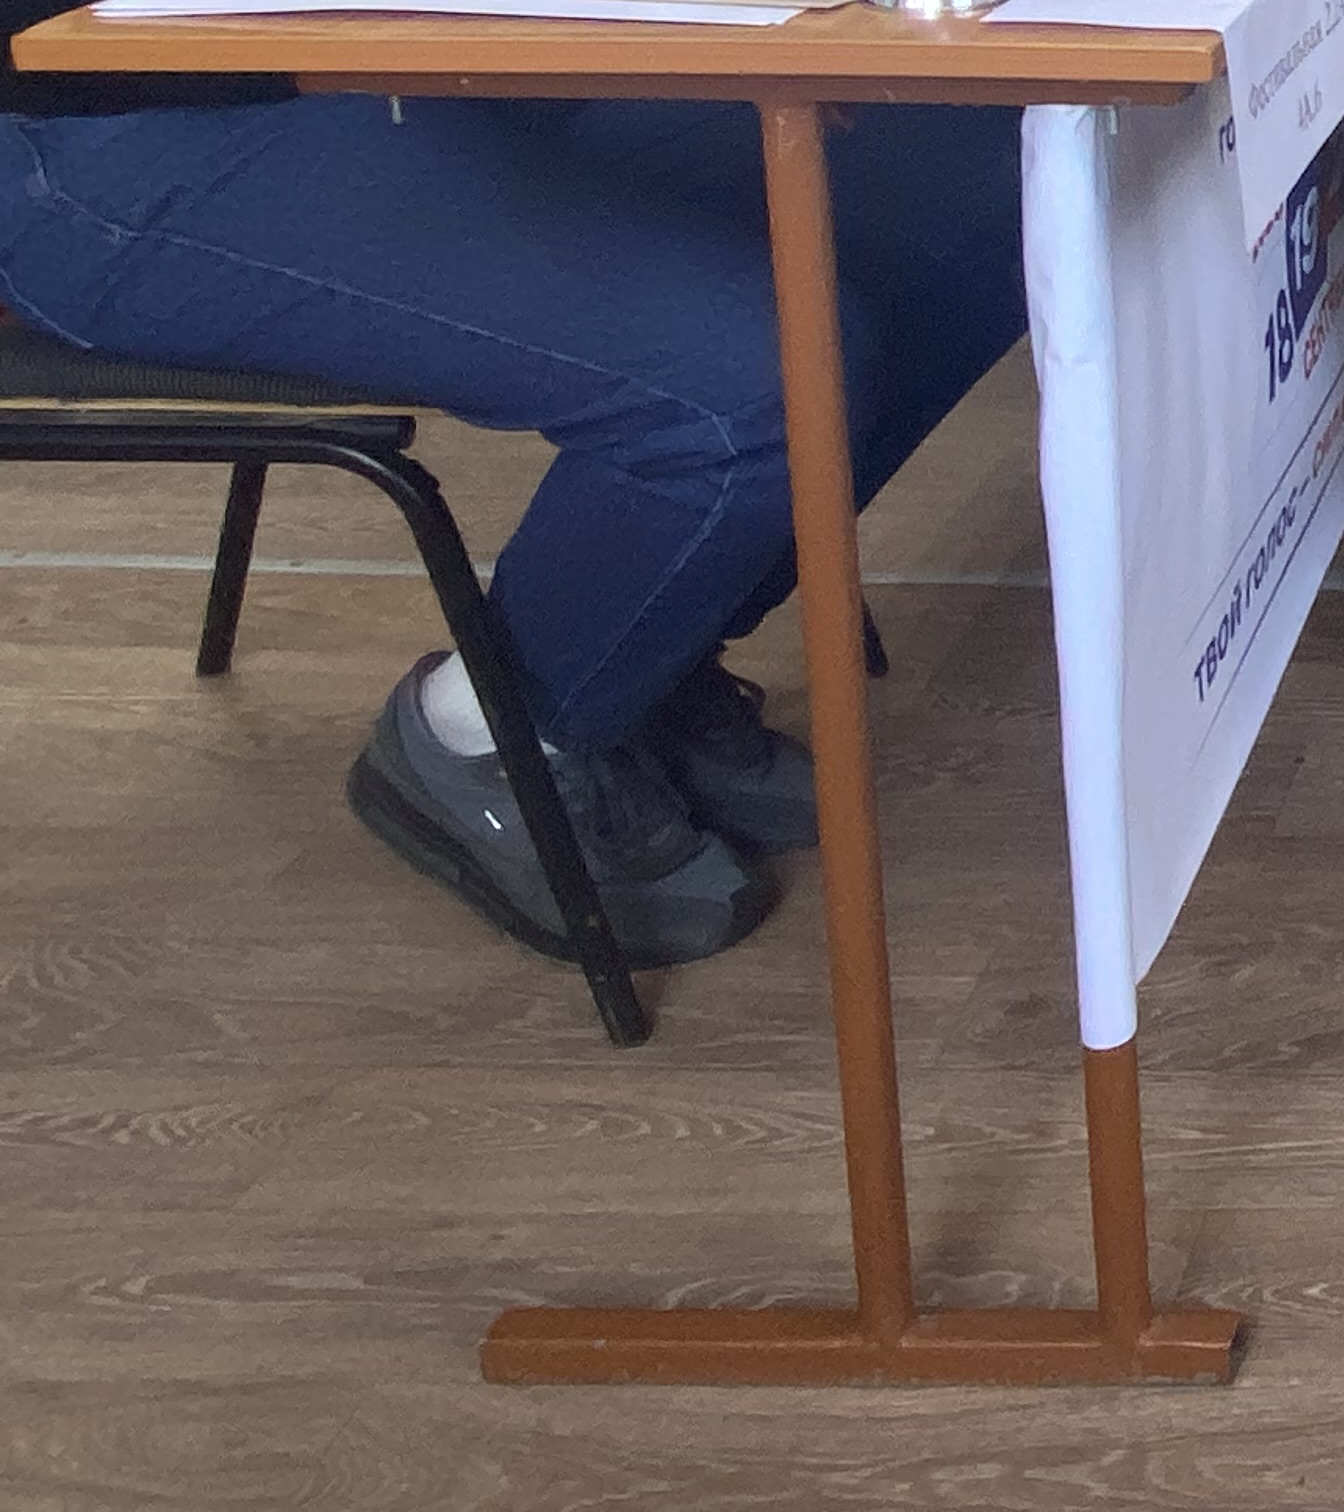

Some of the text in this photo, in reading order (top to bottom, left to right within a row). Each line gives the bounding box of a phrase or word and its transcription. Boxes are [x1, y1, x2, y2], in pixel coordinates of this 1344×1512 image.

[1264, 287, 1294, 404] 18
[1289, 184, 1319, 294] 19
[1194, 577, 1243, 702] ТВОЙ
[1245, 486, 1298, 609] ГОЛОС
